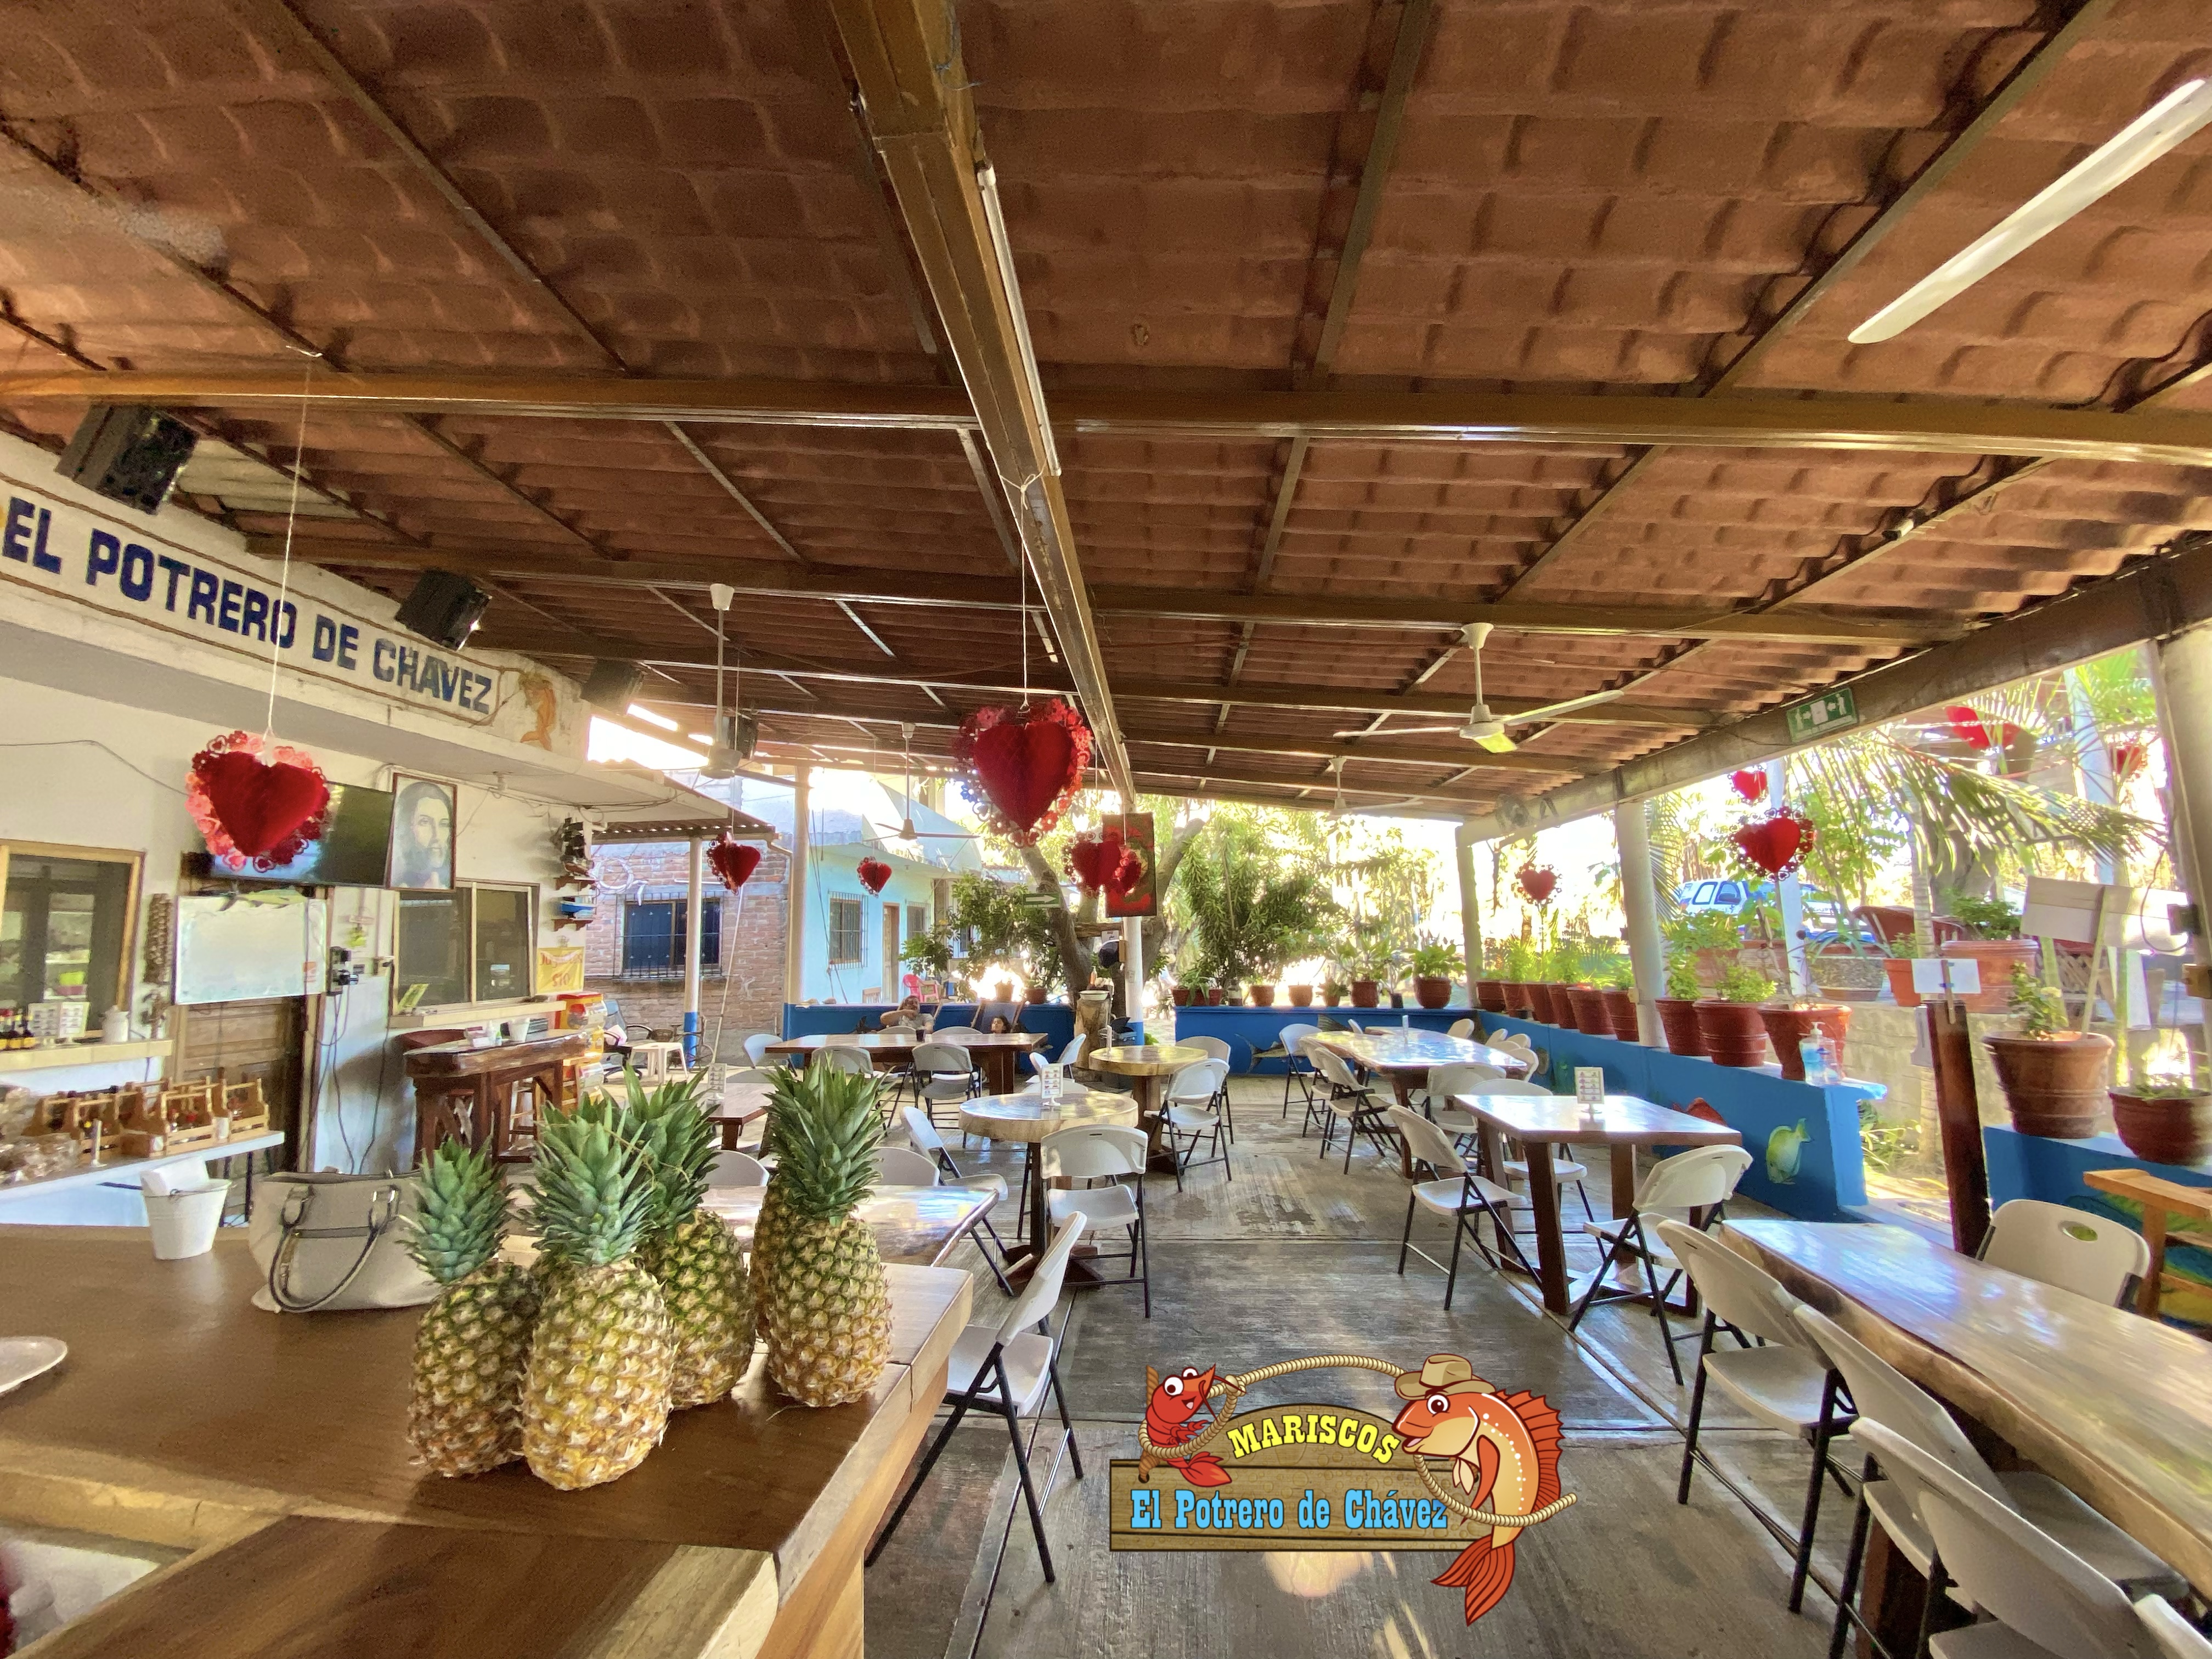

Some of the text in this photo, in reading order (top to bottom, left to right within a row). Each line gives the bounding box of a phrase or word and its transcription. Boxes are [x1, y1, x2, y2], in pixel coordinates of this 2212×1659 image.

[3, 496, 492, 715] EL POTRERO DE CHAVEZ
